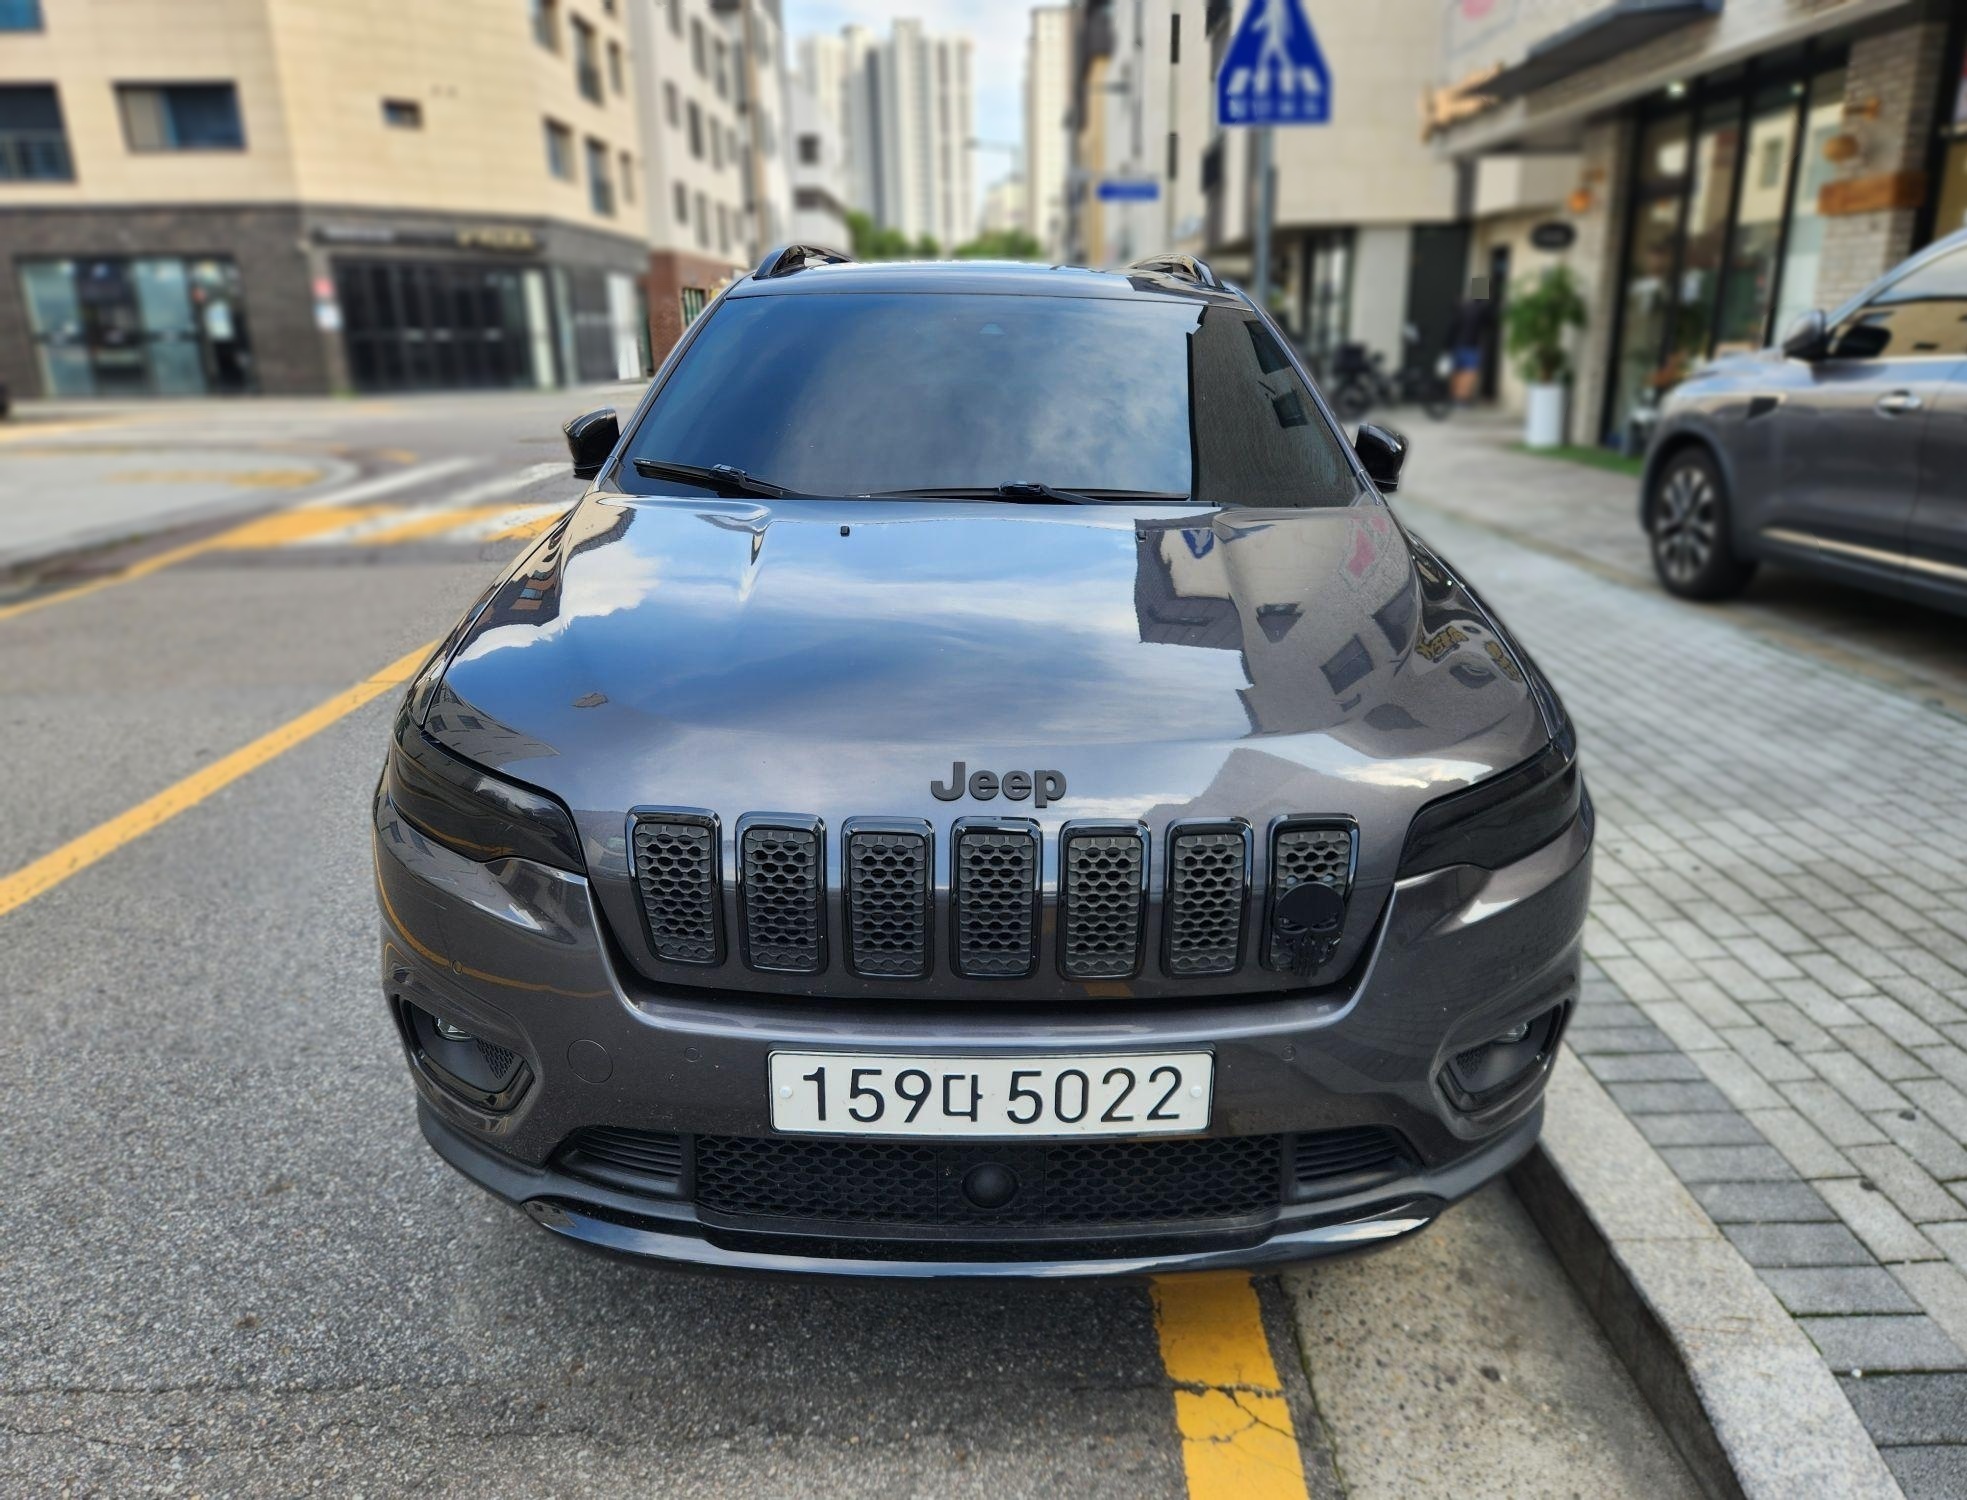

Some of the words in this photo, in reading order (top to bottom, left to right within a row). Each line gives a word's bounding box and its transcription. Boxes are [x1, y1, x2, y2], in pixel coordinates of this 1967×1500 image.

[930, 761, 1067, 808] Jeep
[802, 1066, 984, 1123] 159다
[1006, 1065, 1184, 1125] 5022
